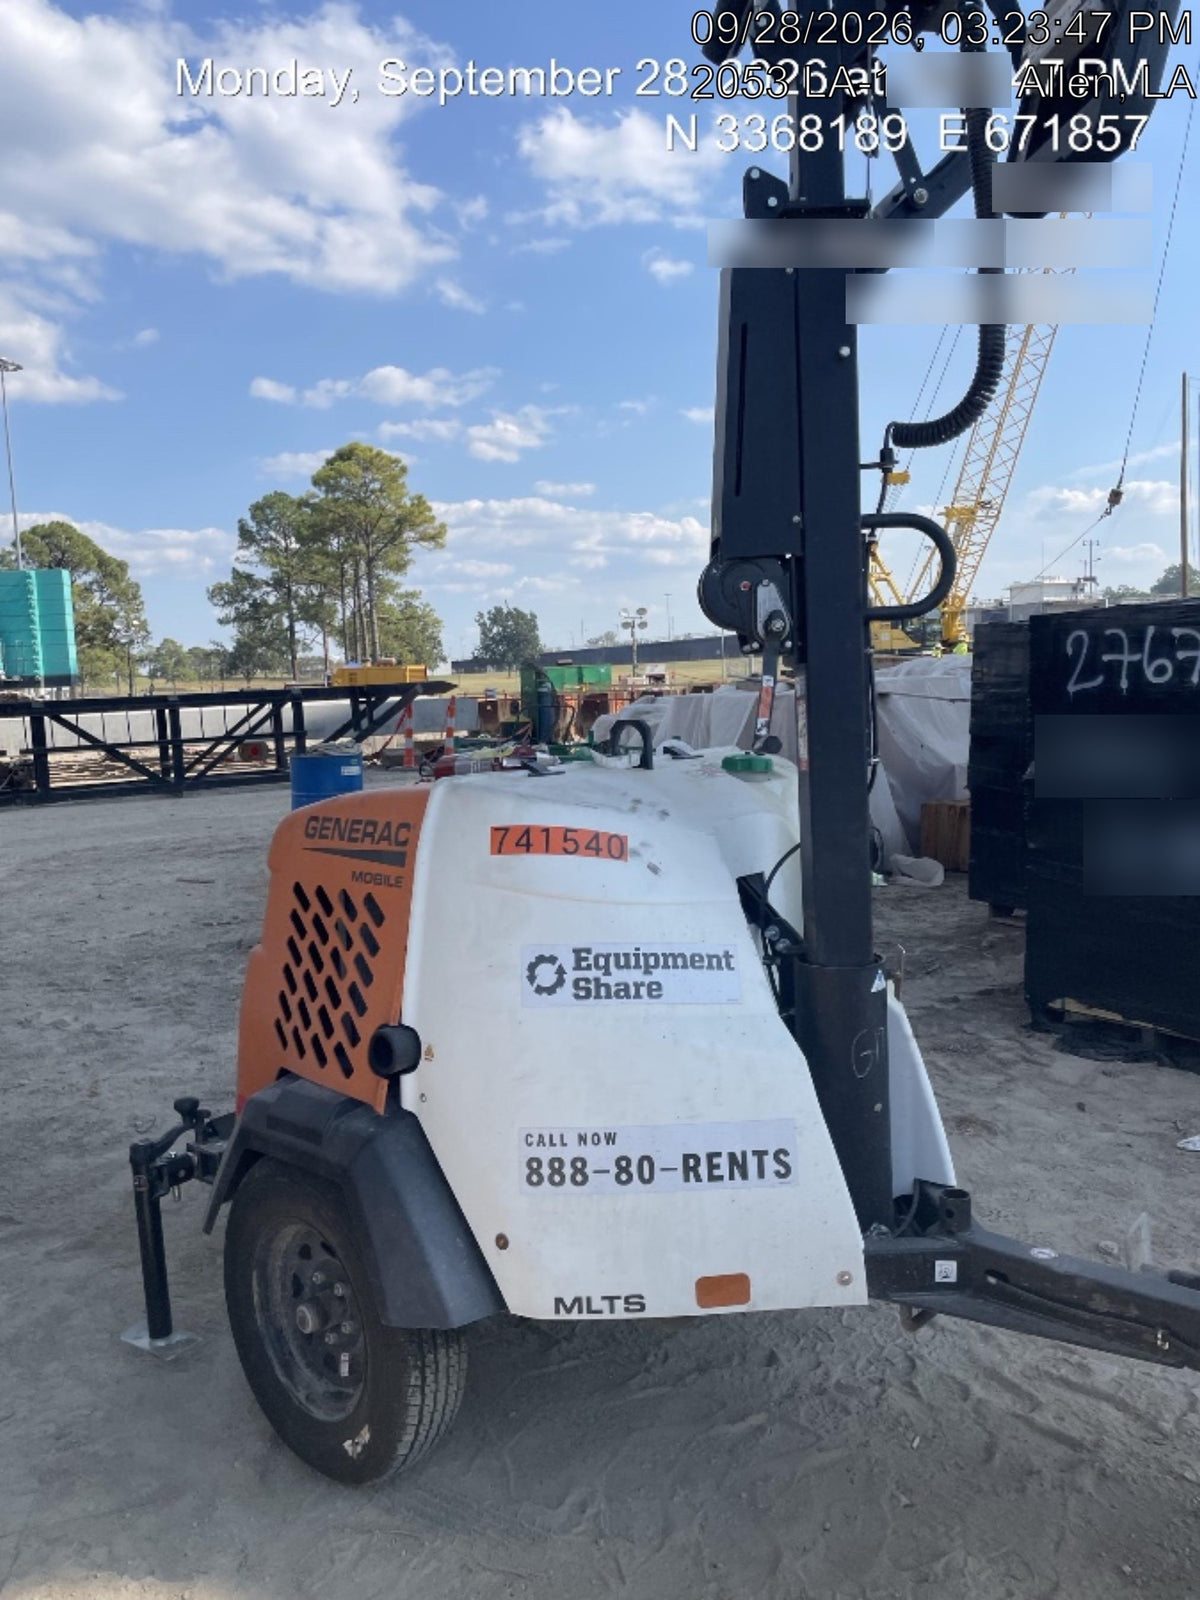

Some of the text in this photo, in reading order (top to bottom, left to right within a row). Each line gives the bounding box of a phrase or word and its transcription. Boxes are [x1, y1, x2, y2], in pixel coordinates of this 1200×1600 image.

[305, 815, 412, 848] GENERAC
[493, 826, 627, 860] 741540
[351, 870, 404, 889] MOBILE
[572, 947, 735, 977] Equipment
[572, 976, 664, 1001] Share
[525, 1131, 618, 1148] CALL NOW
[525, 1148, 793, 1188] 888-80-RENTS
[553, 1293, 647, 1316] MLTS
